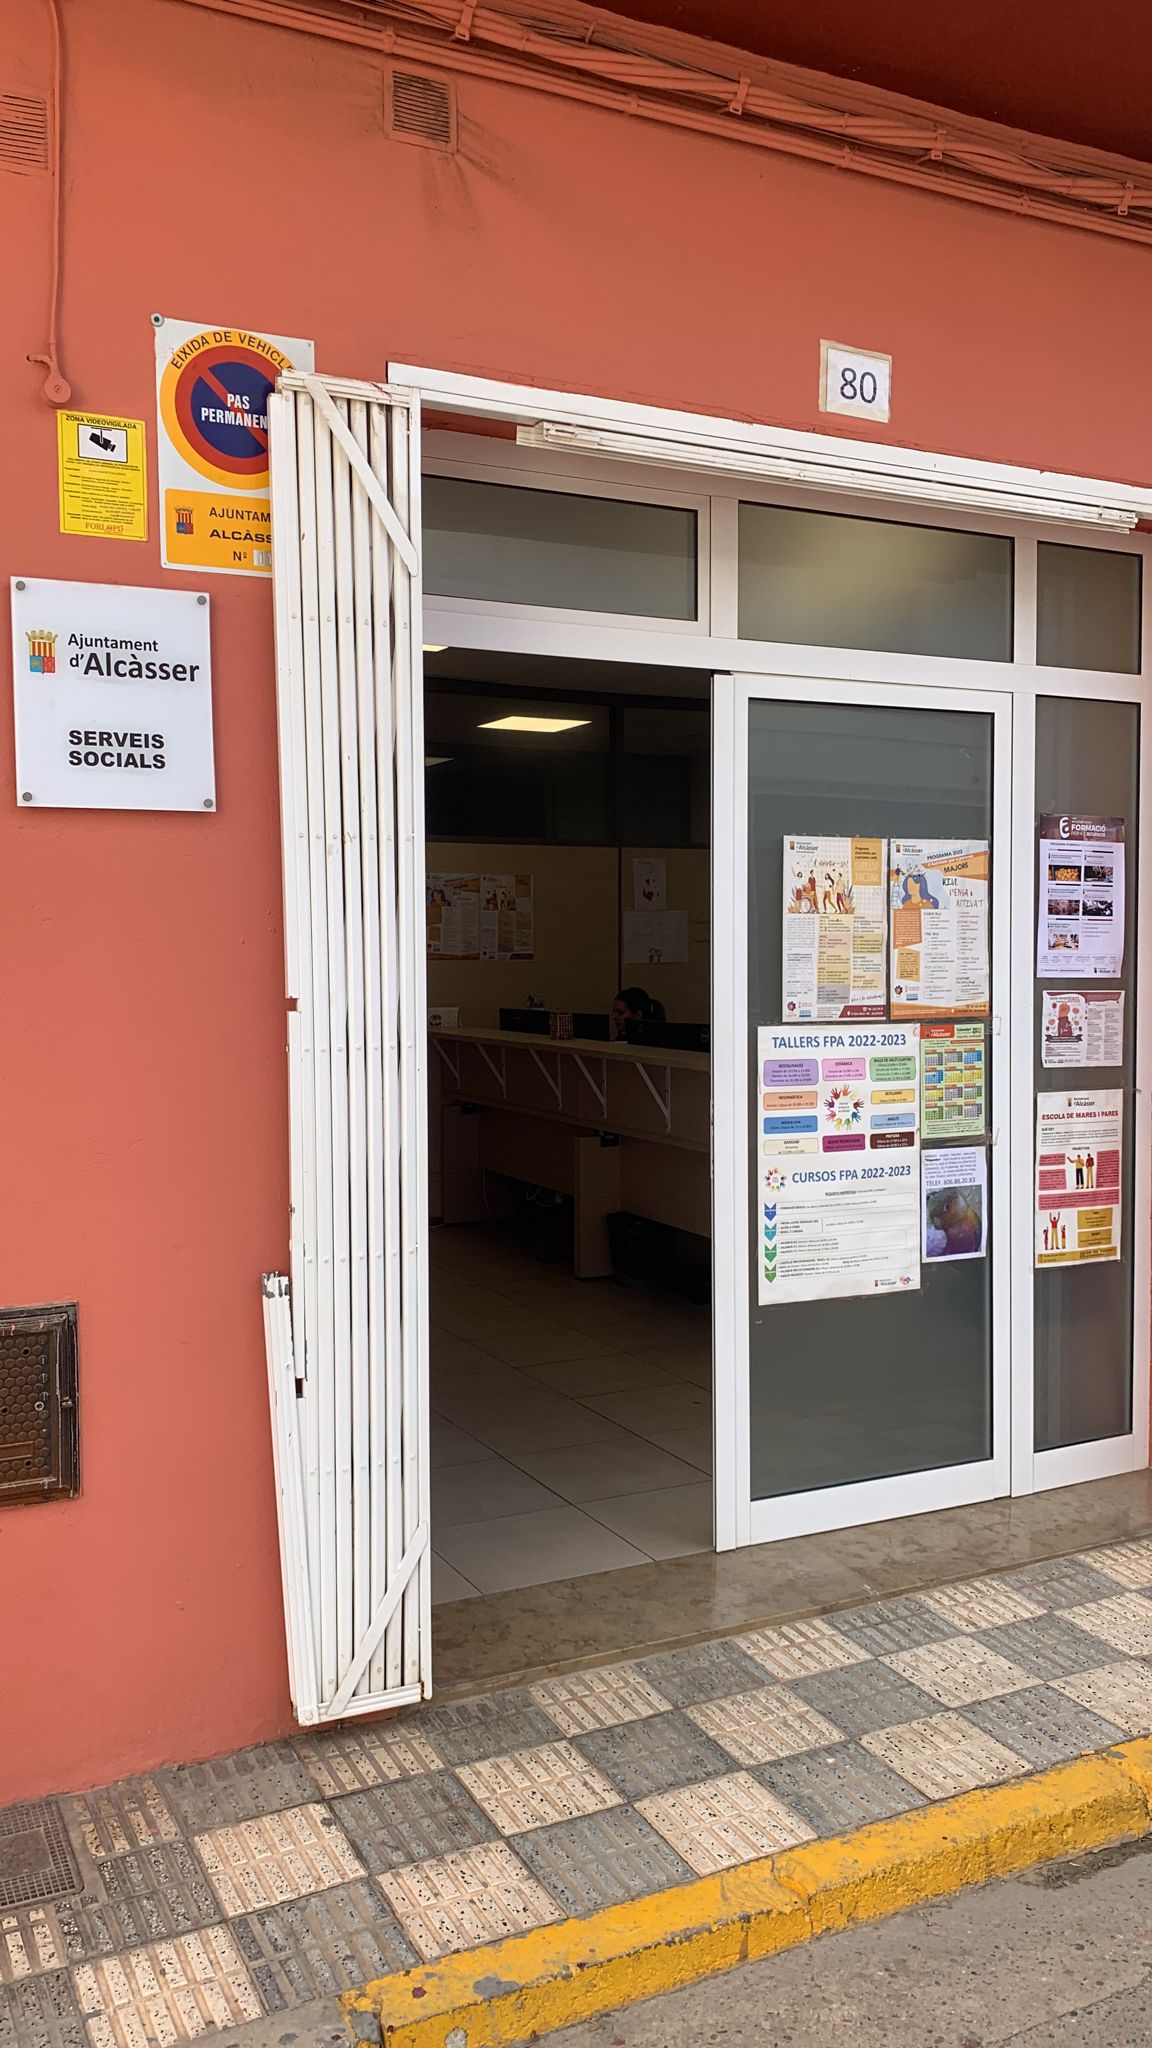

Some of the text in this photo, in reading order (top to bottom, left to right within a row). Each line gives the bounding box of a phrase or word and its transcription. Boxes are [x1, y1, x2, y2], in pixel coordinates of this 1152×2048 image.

[171, 335, 210, 370] EIXIDA
[212, 331, 233, 343] DE
[840, 367, 877, 404] 80
[226, 393, 250, 409] PAS
[66, 414, 137, 430] ZONA VIDEOVIGILADA
[232, 550, 248, 561] Nº
[67, 633, 159, 652] Ajuntament
[69, 652, 200, 682] d'Alcàsser
[68, 729, 165, 749] SERVEIS
[68, 750, 166, 769] SOCIALS
[1071, 823, 1107, 832] FORMACIÓ
[926, 851, 952, 861] PROGRAMA
[943, 862, 969, 873] MAJORS
[772, 1034, 906, 1049] TALLERS FPA 2022-2023
[792, 1170, 836, 1184] CURSOS
[839, 1169, 858, 1181] FPA
[861, 1165, 911, 1179] 2022-2023
